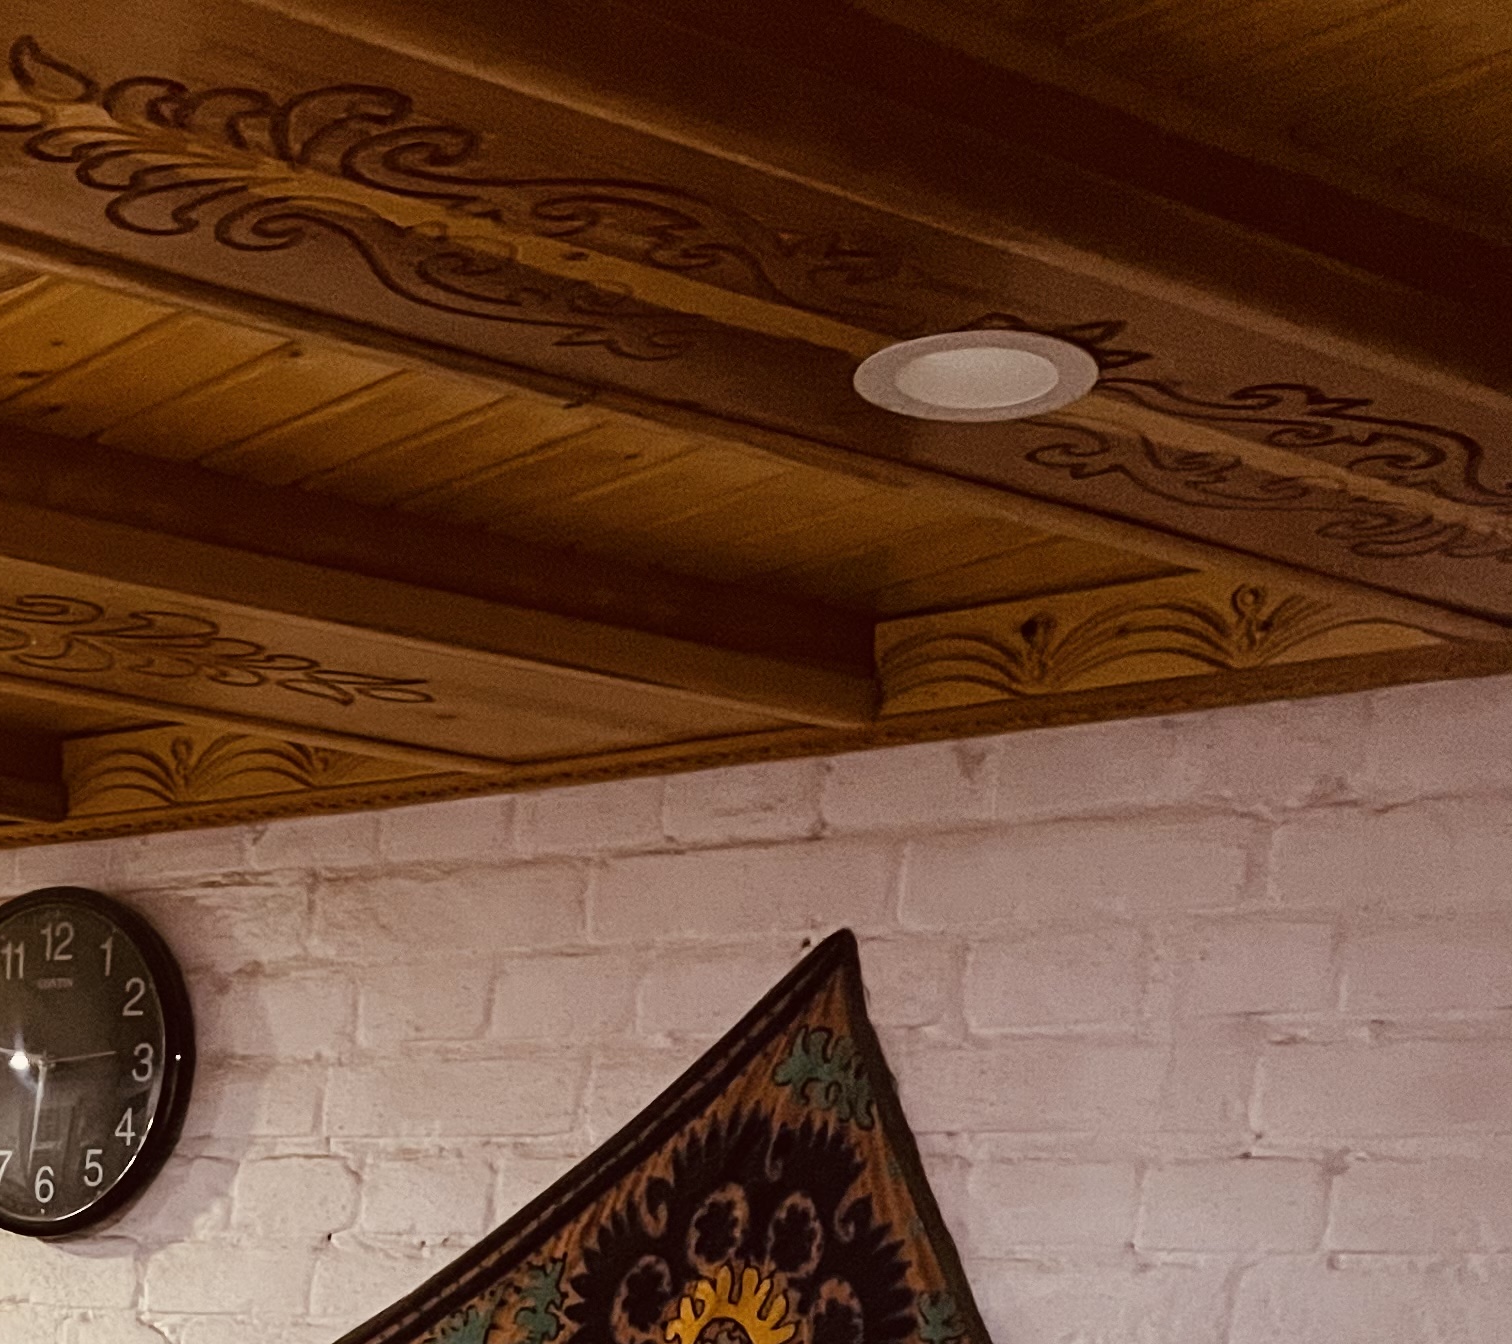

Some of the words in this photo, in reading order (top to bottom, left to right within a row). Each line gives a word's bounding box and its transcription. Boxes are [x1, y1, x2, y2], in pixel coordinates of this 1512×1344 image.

[1, 941, 25, 979] 11
[40, 921, 74, 961] 12
[100, 936, 113, 976] 1
[122, 977, 146, 1016] 2
[131, 1043, 154, 1082] 3
[114, 1107, 136, 1146] 4
[35, 1165, 55, 1203] 6
[83, 1149, 103, 1187] 5
